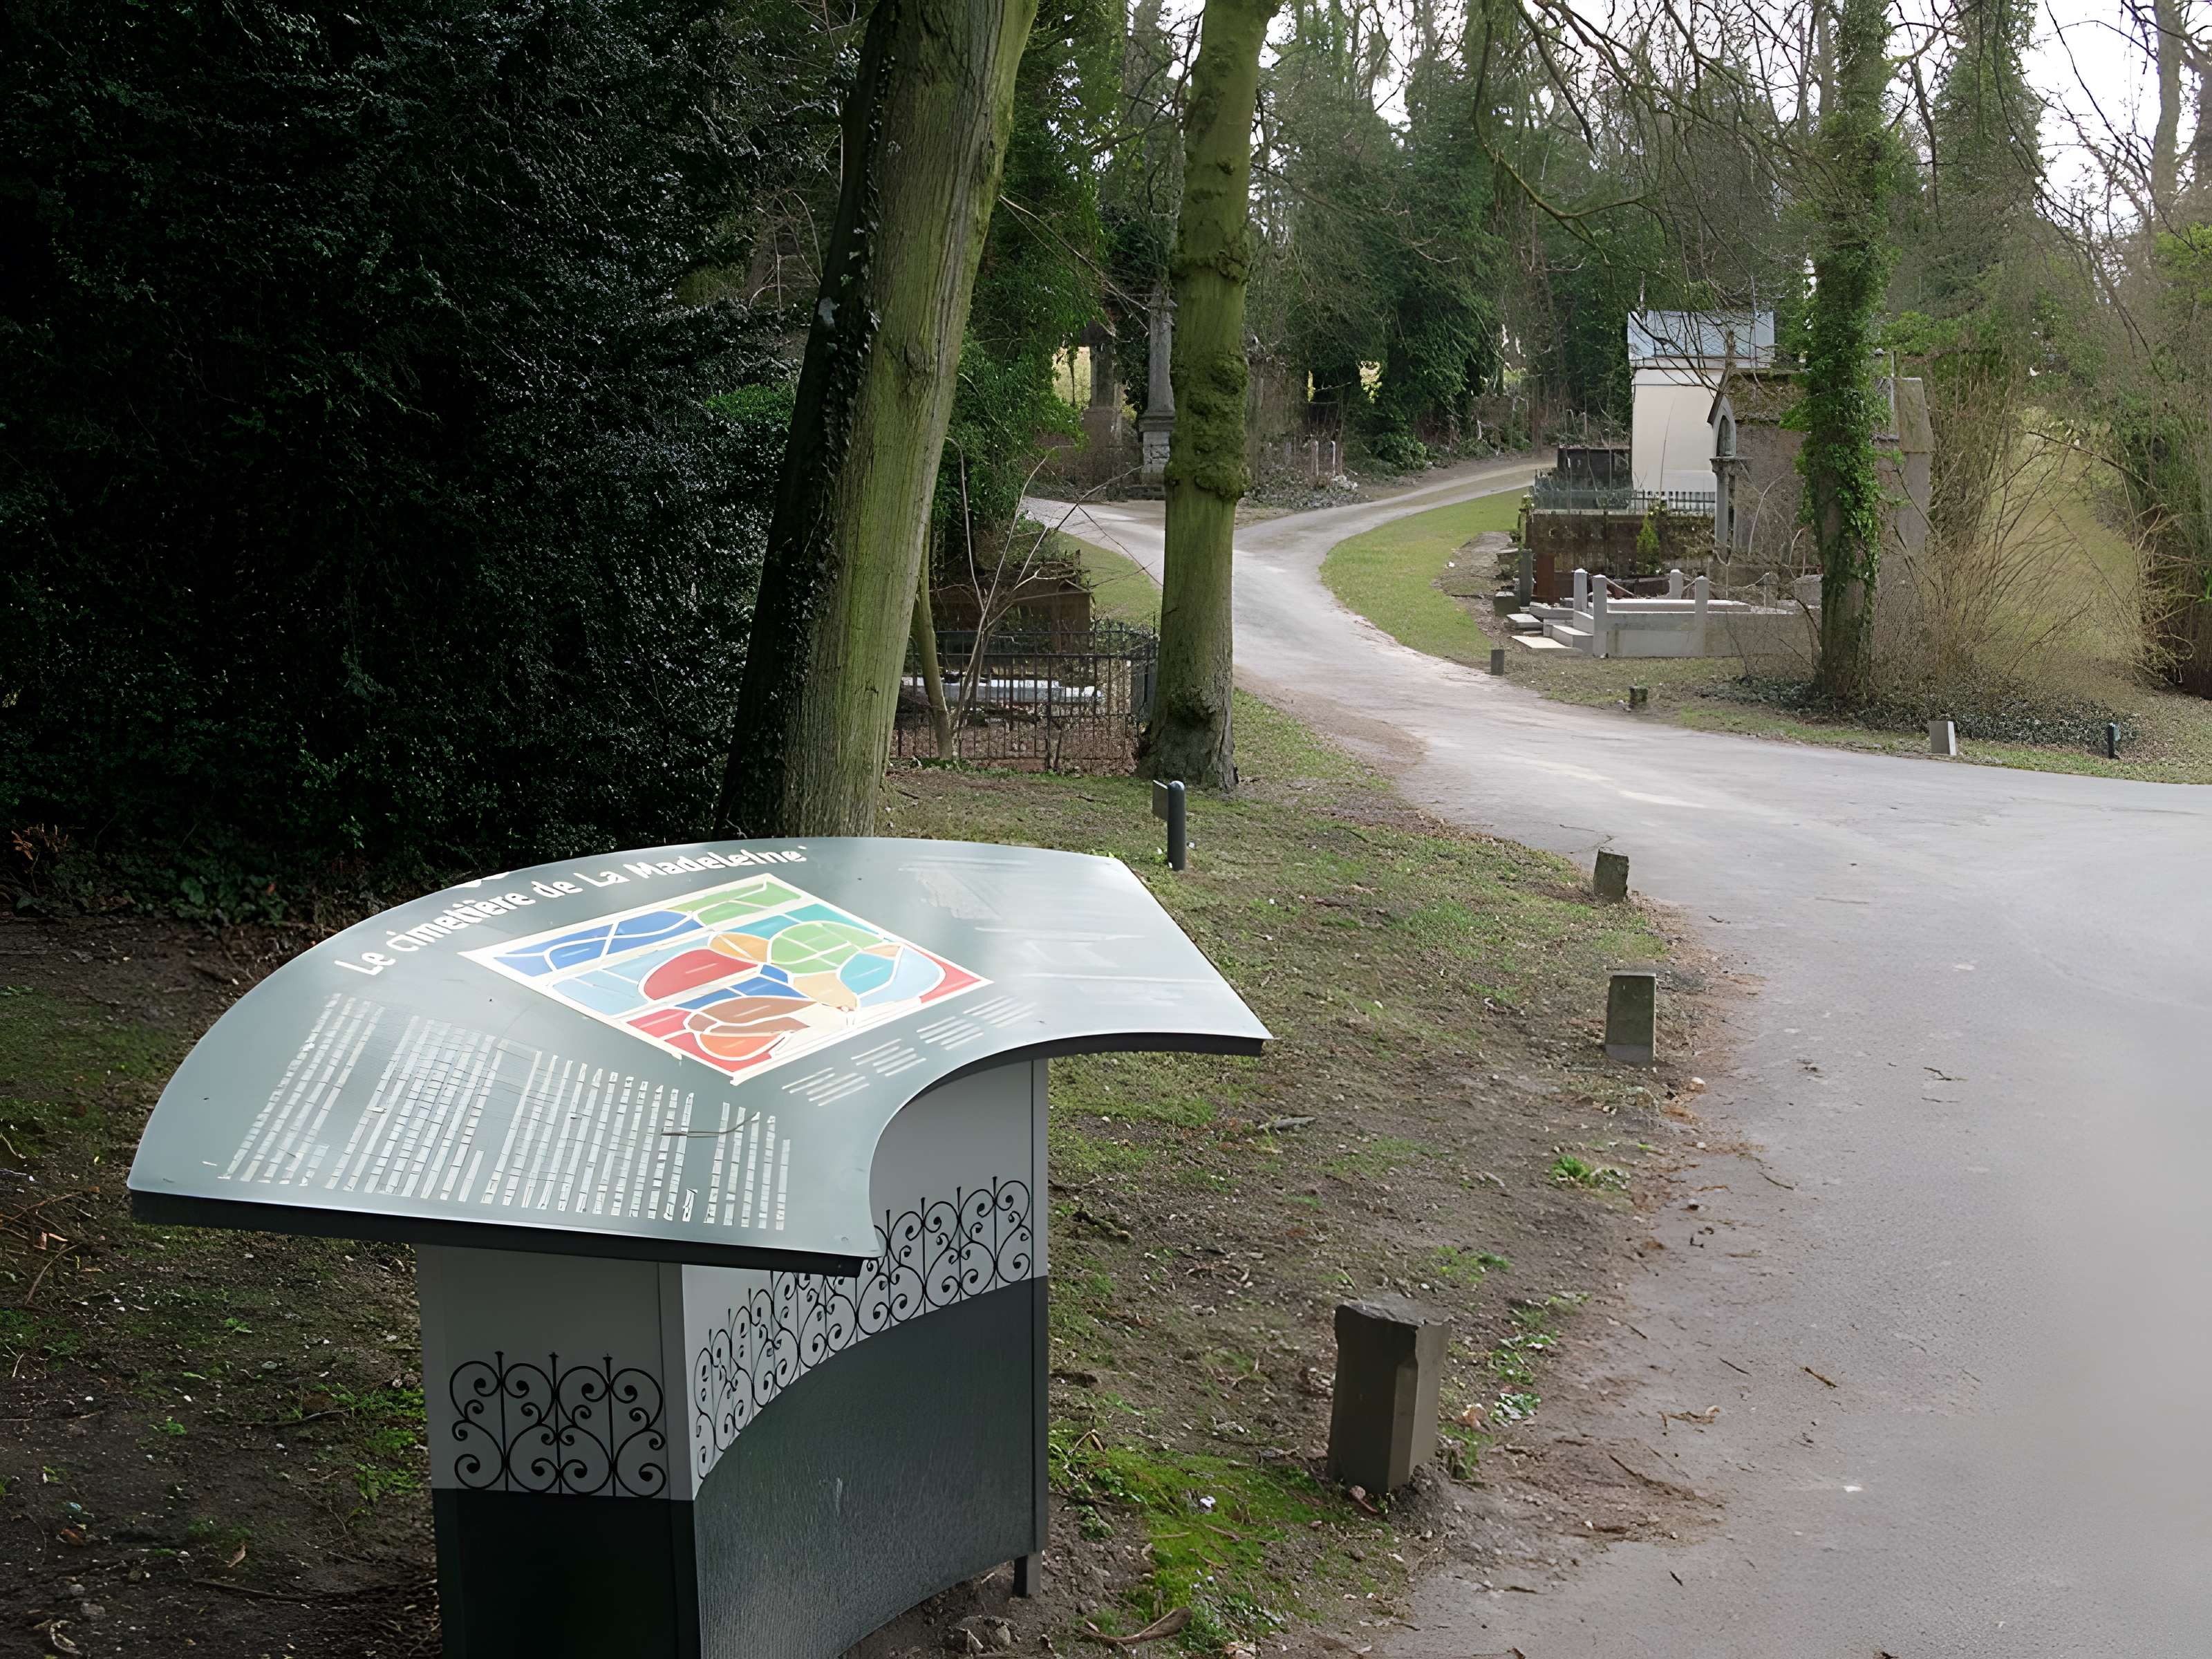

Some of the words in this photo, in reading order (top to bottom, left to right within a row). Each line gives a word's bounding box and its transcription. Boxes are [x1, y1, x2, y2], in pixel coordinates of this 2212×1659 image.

[334, 952, 396, 975] Le
[531, 881, 583, 898] de
[623, 849, 807, 879] Madeleine
